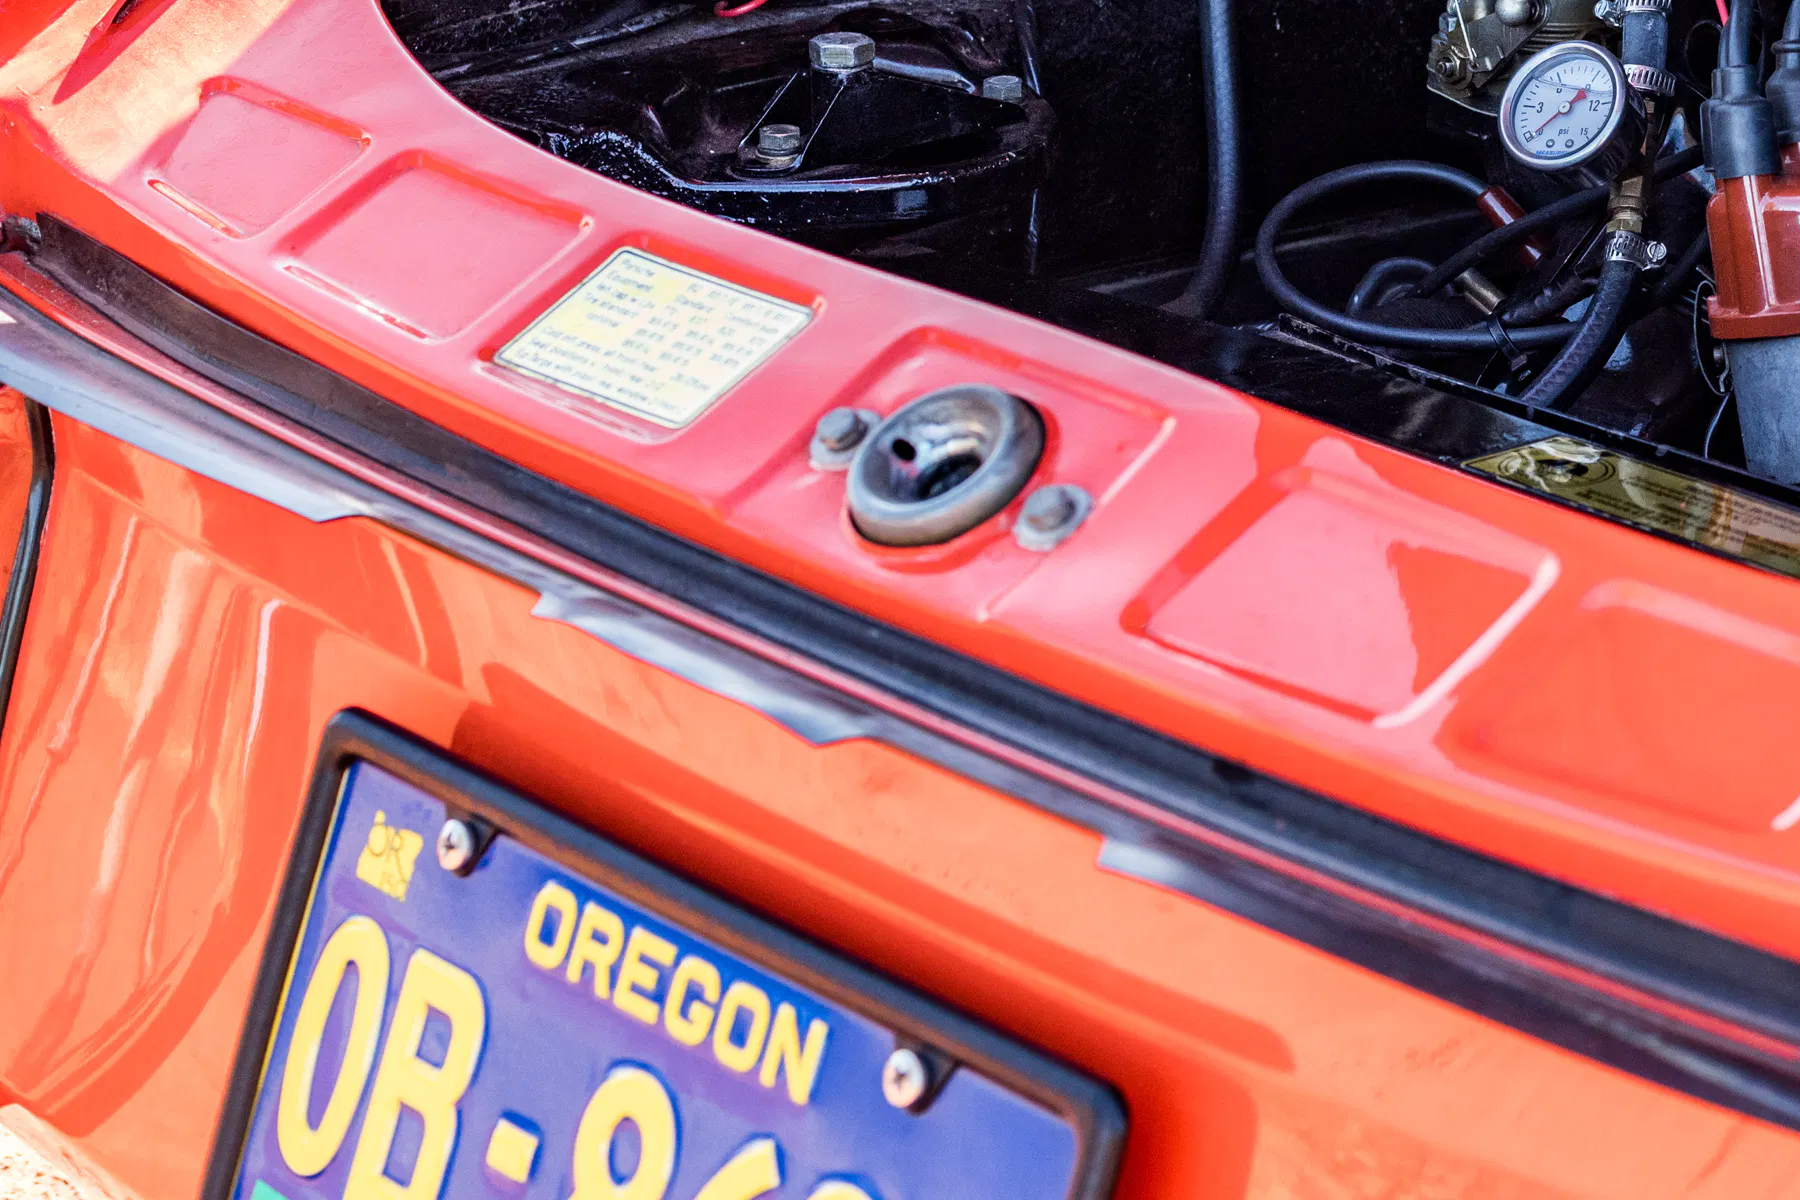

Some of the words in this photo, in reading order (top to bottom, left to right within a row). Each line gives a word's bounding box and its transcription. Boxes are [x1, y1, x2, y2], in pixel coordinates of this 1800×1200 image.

[1536, 101, 1544, 114] 3
[1588, 99, 1600, 112] 12
[1558, 126, 1570, 136] psi
[1580, 127, 1589, 136] 15
[523, 879, 829, 1106] OREGON
[276, 914, 877, 1200] OB-8
